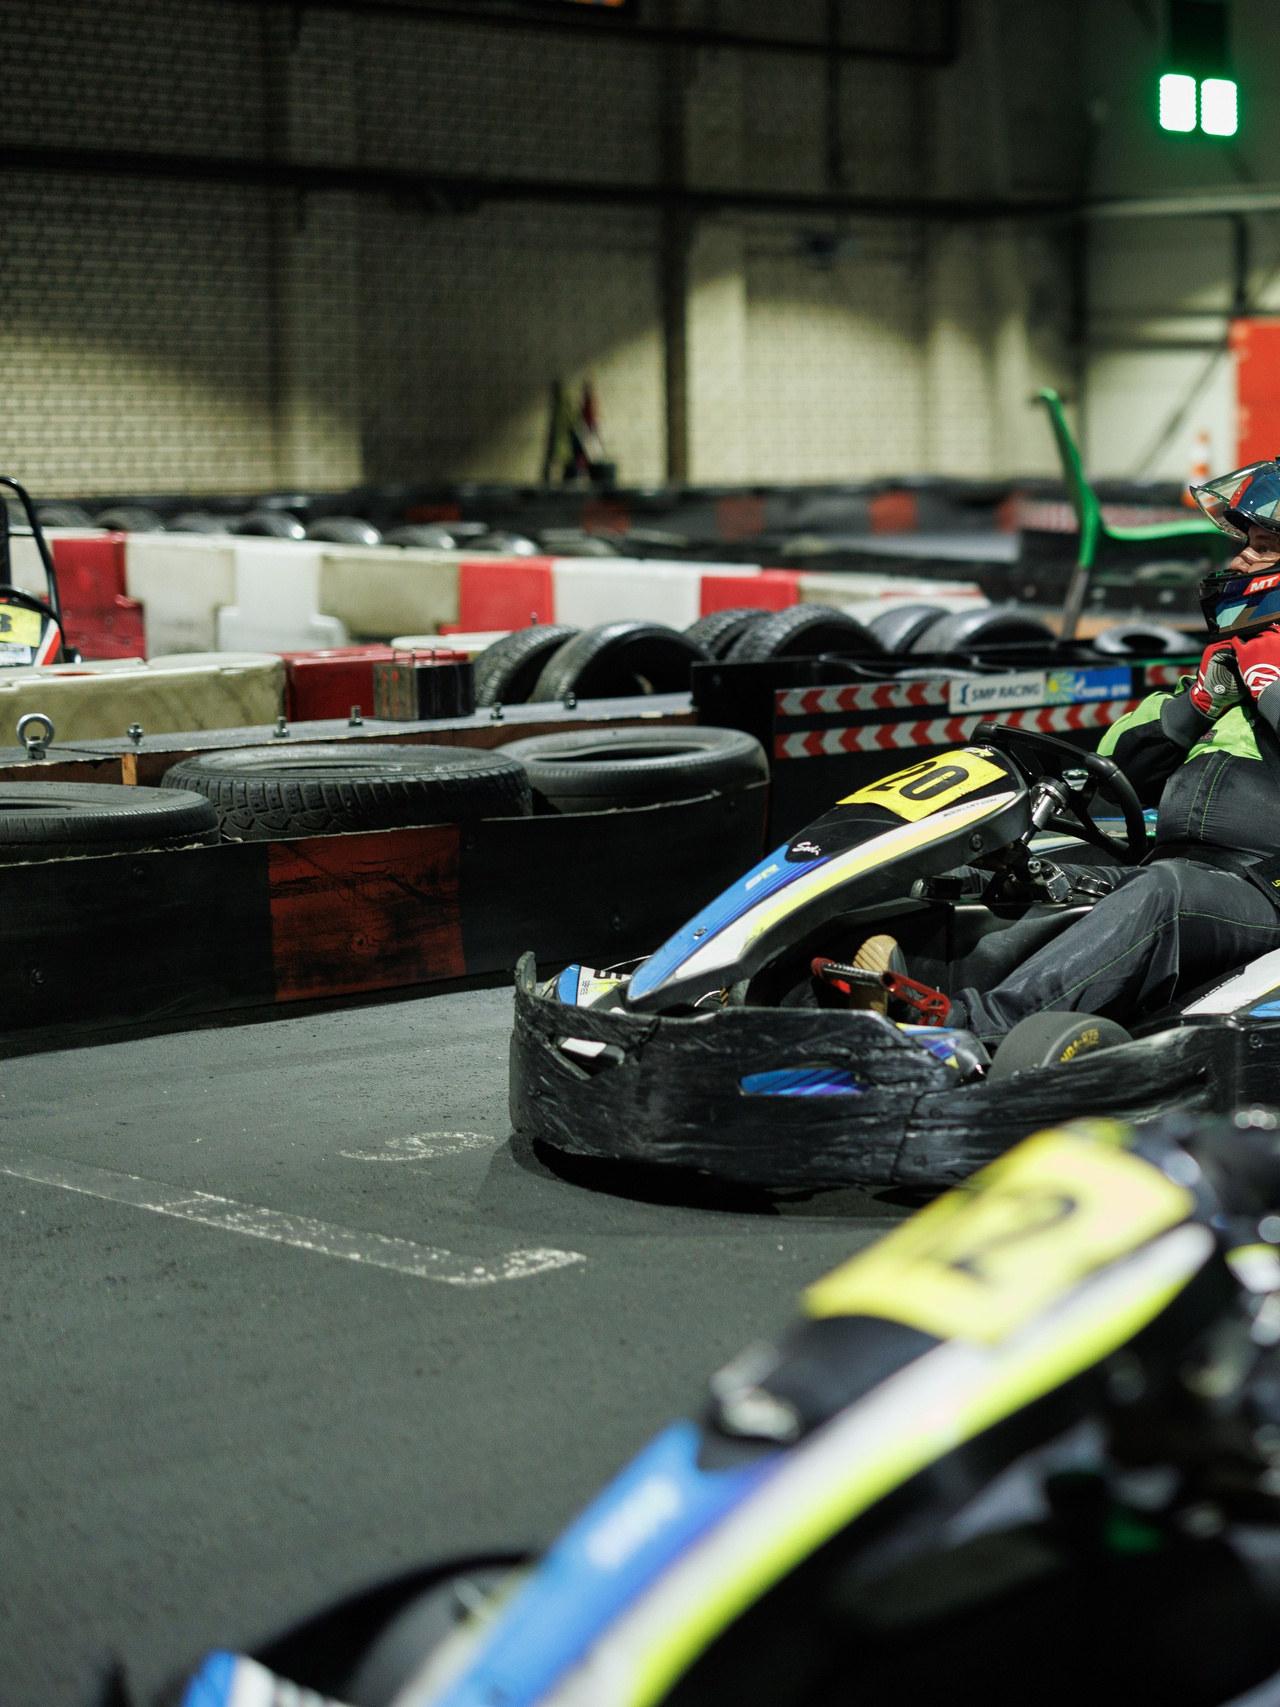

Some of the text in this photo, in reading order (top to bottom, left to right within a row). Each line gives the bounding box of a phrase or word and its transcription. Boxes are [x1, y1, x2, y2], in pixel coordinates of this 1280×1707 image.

[1250, 575, 1280, 592] MT
[971, 682, 1041, 701] SMP RACING
[867, 761, 969, 801] 20
